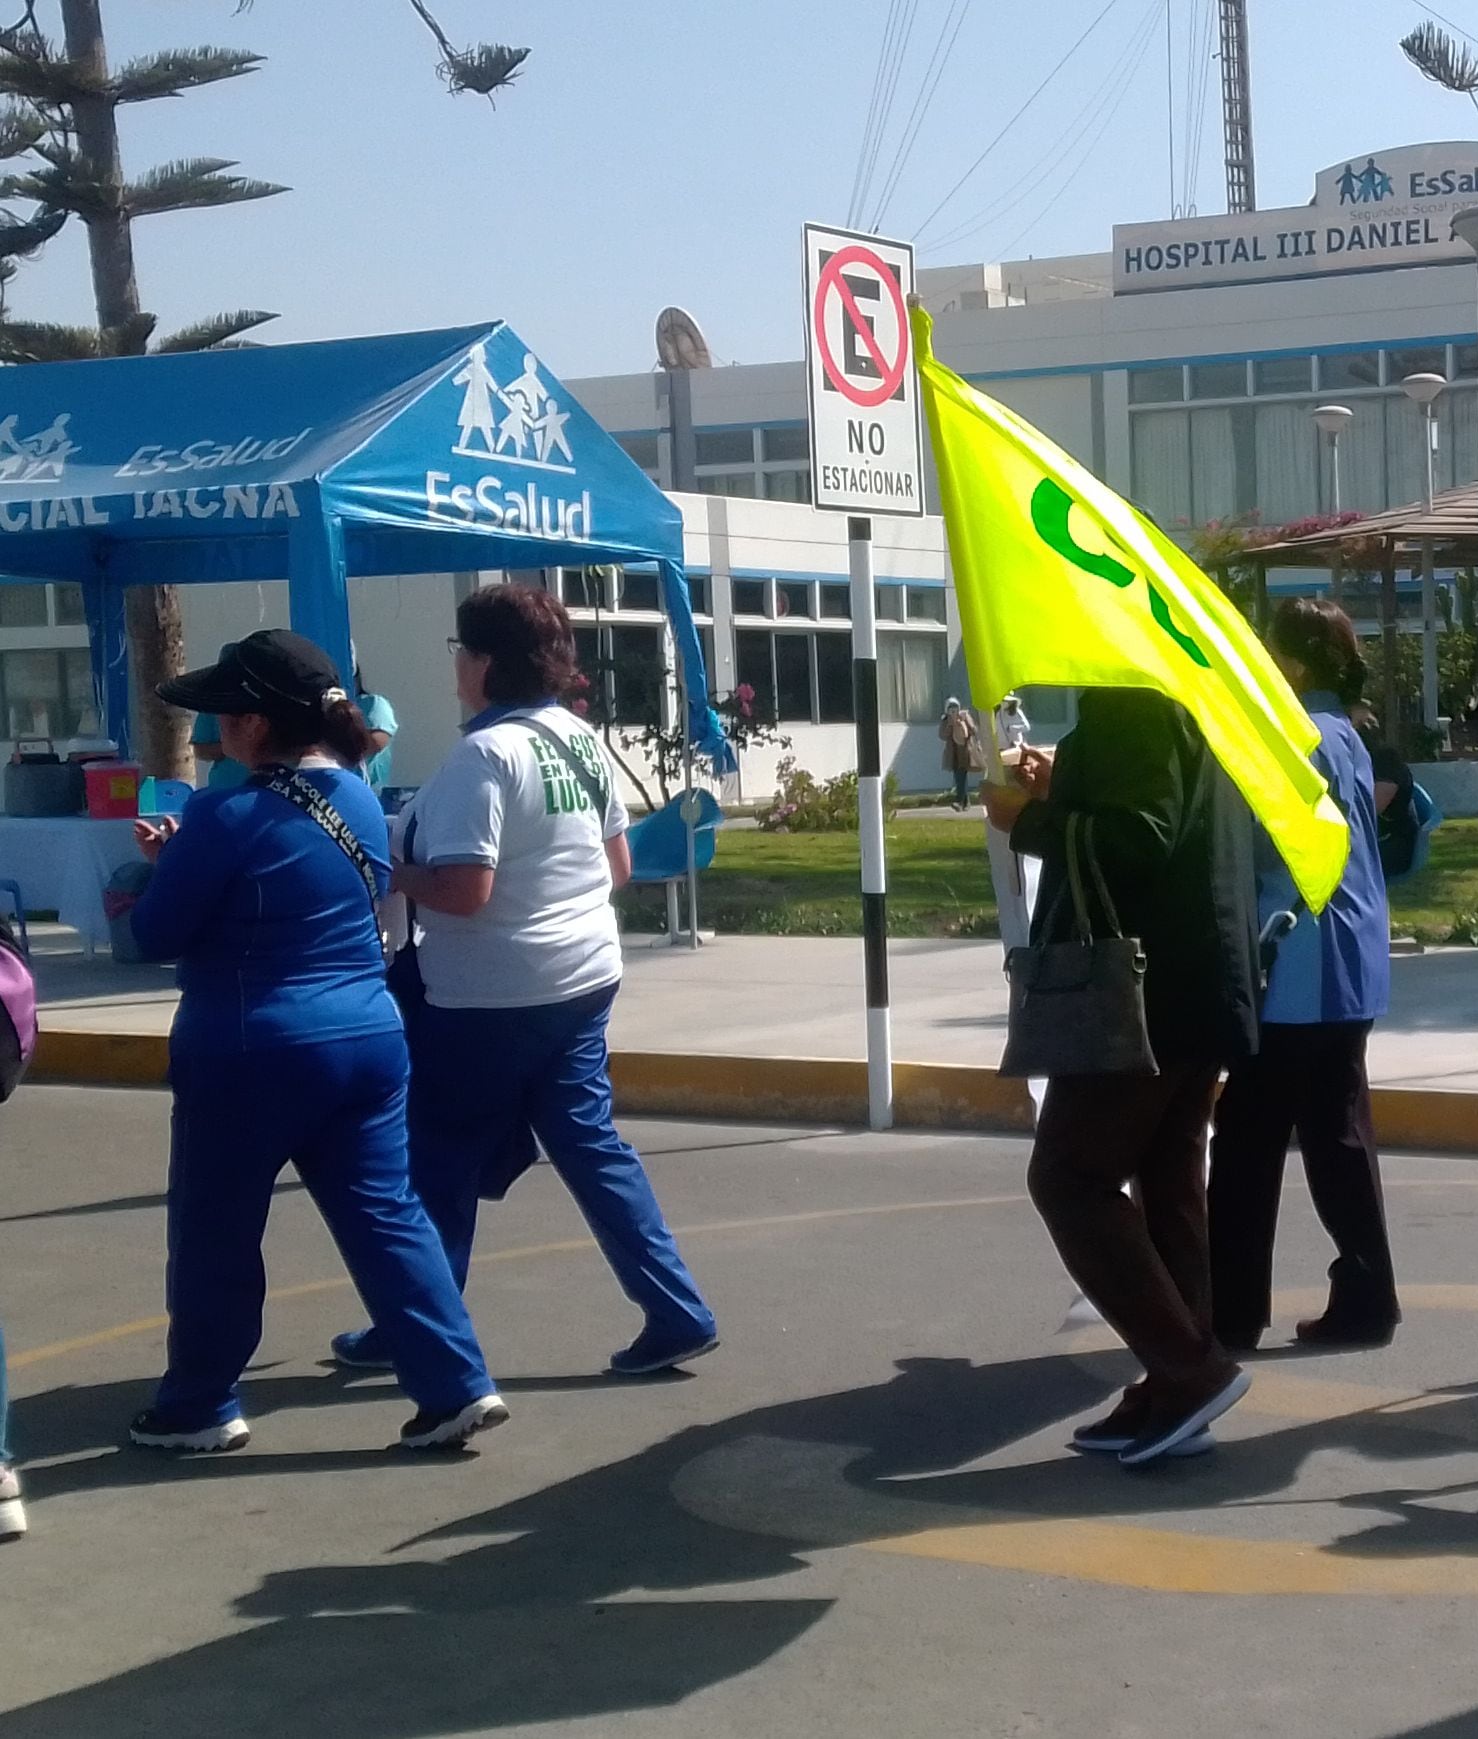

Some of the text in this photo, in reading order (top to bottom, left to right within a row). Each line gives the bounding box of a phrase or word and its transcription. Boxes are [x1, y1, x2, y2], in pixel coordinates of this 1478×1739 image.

[1125, 236, 1266, 273] HOSPITAL
[1276, 230, 1316, 259] III
[1326, 218, 1439, 254] DANIEL
[113, 427, 314, 478] EsSalud
[847, 419, 885, 456] NO
[426, 470, 591, 541] EsSalud
[822, 465, 914, 498] ESTACIONAR
[290, 773, 328, 810] NICOLE
[325, 805, 344, 829] LEE
[340, 824, 359, 853] USA
